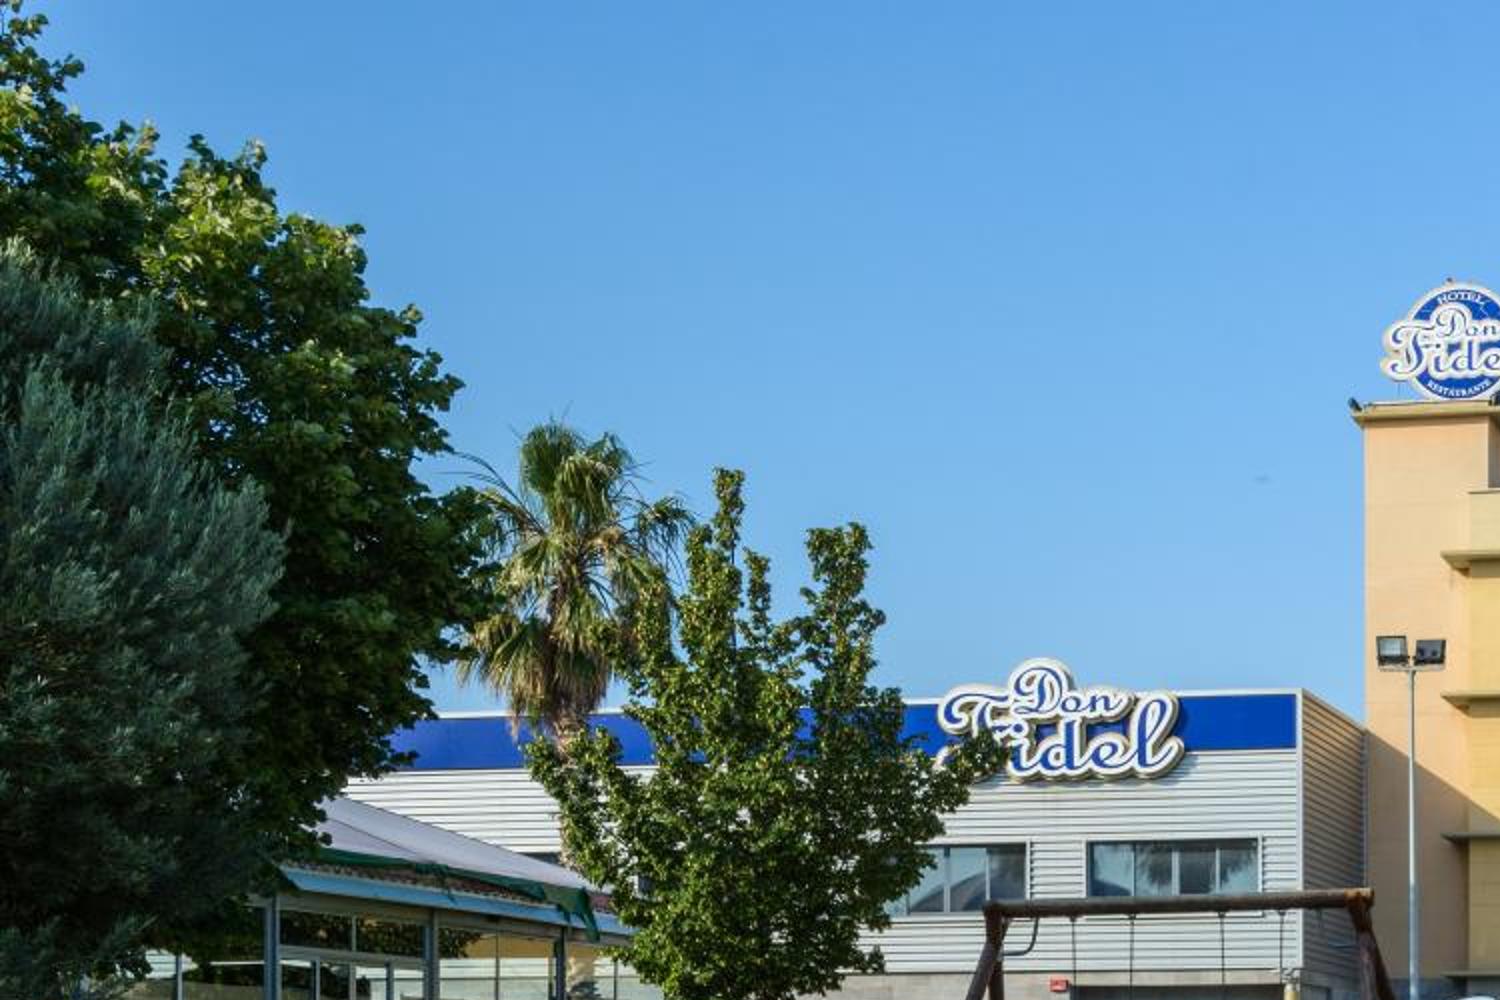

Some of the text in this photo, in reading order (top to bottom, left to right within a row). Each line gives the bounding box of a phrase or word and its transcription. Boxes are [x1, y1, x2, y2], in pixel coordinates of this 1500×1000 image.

[1437, 292, 1485, 304] HOTEL
[1434, 307, 1500, 338] Don
[1427, 379, 1492, 397] RESTAURANTE
[1013, 666, 1121, 715] Don
